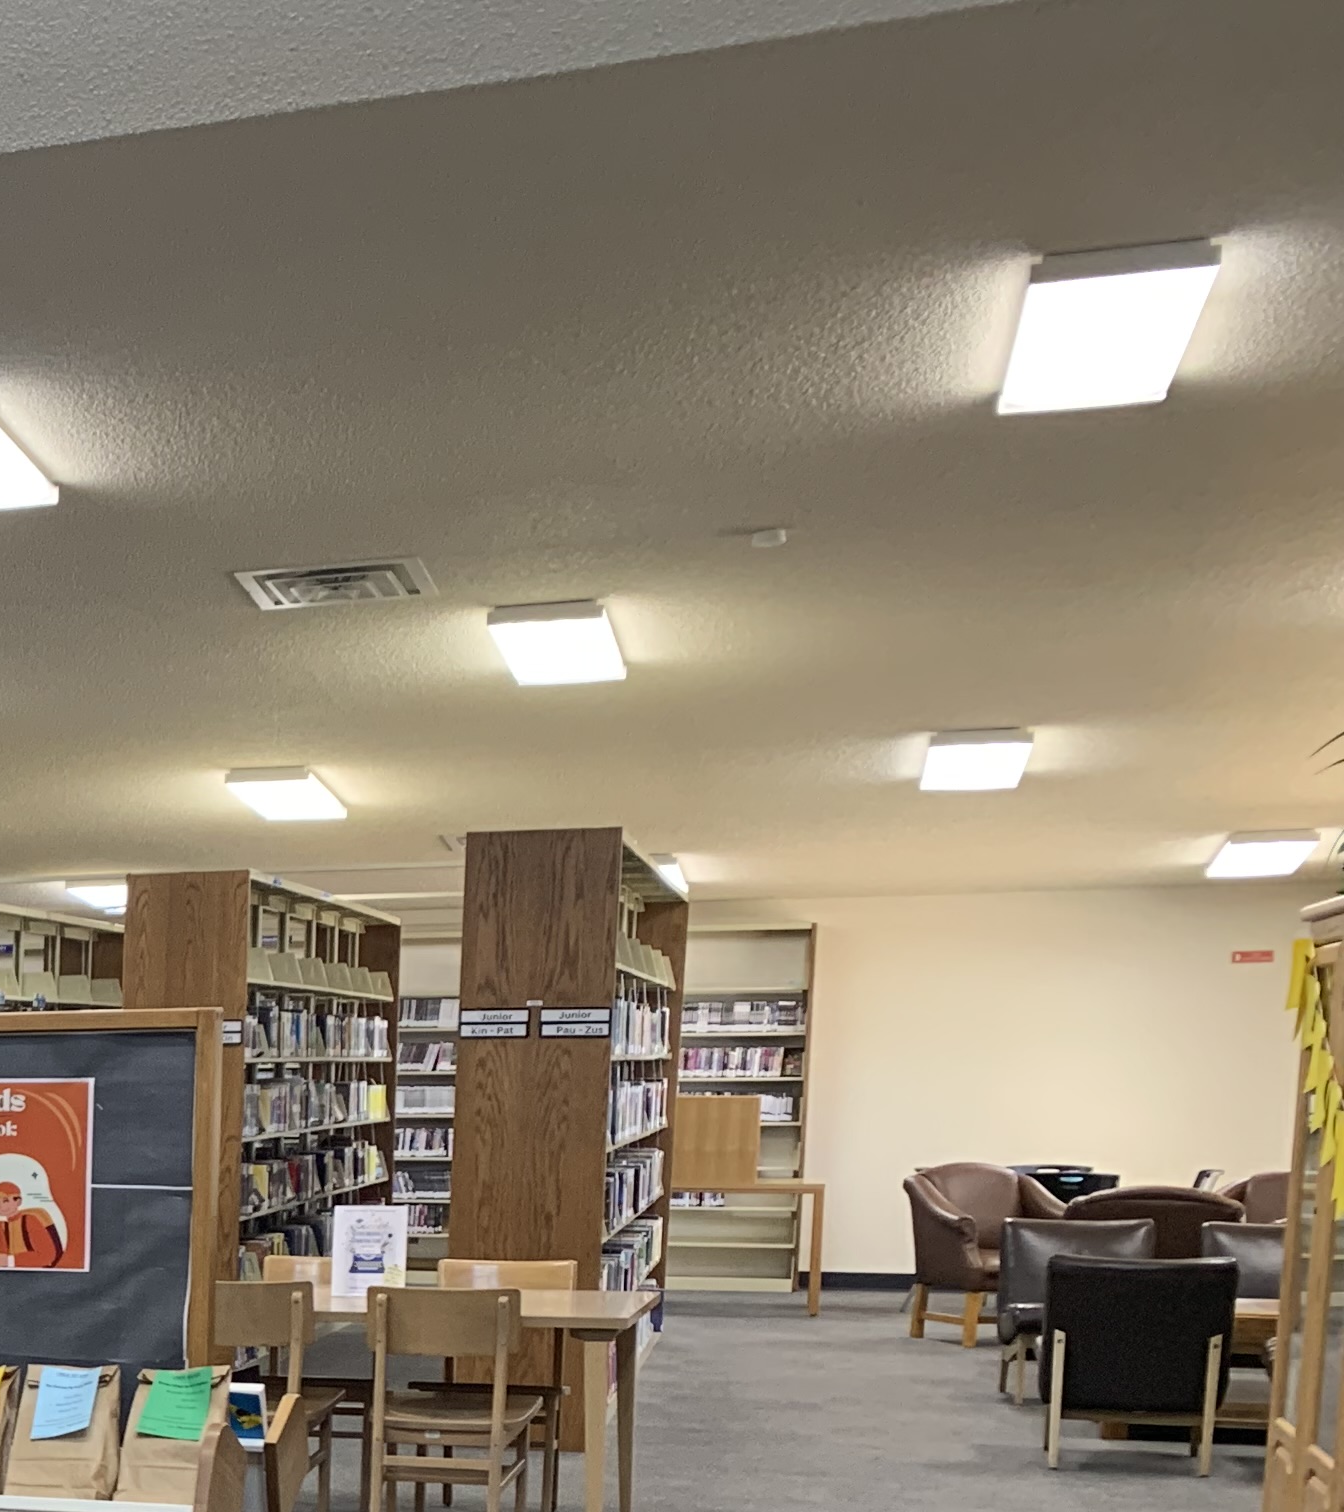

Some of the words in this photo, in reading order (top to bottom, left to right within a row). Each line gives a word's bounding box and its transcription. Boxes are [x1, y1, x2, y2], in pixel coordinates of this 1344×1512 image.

[559, 1010, 592, 1019] Junior
[496, 1026, 514, 1034] Pat
[556, 1025, 576, 1034] Pau
[585, 1025, 604, 1034] Zus
